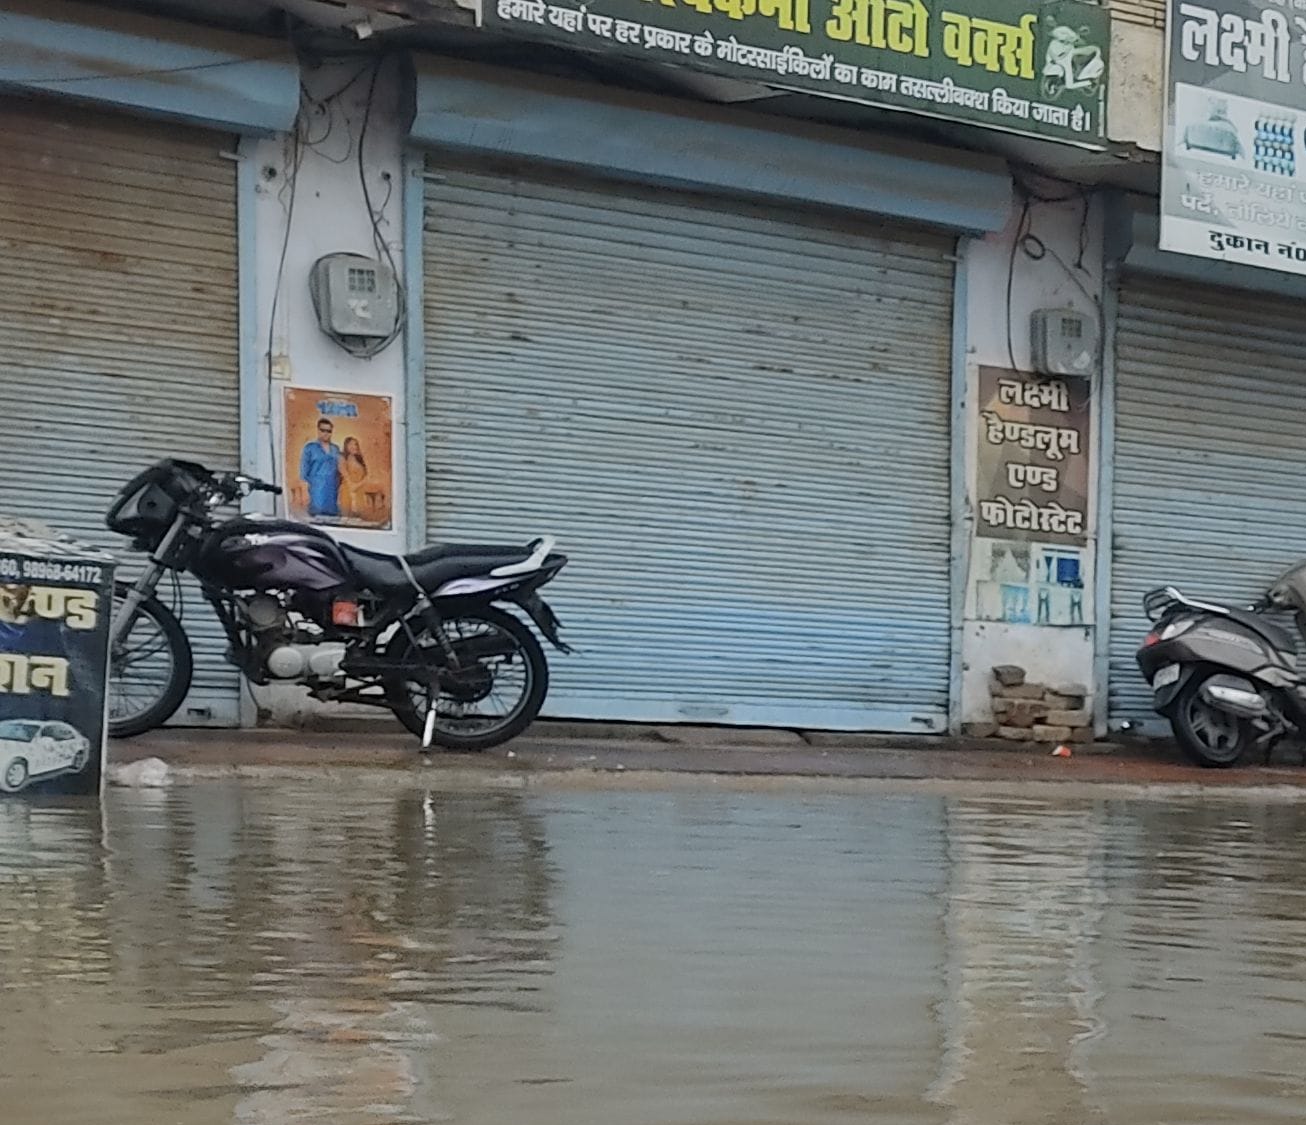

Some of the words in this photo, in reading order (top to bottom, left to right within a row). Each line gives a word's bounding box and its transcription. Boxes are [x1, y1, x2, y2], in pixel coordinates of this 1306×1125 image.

[1179, 3, 1291, 83] लक्ष्मी
[497, 0, 545, 24] हमारे
[587, 13, 614, 38] पर
[615, 20, 641, 44] हर
[643, 24, 692, 53] प्रकार
[694, 31, 712, 57] के
[834, 63, 858, 85] का
[860, 68, 898, 93] काम
[992, 88, 1030, 119] किया
[1031, 102, 1069, 127] जाता
[1209, 230, 1271, 255] दुकान
[999, 378, 1069, 412] लक्ष्मी
[981, 410, 1079, 461] हैण्डलूम
[1006, 462, 1058, 491] एण्ड
[980, 497, 1082, 534] फोटोस्टेट
